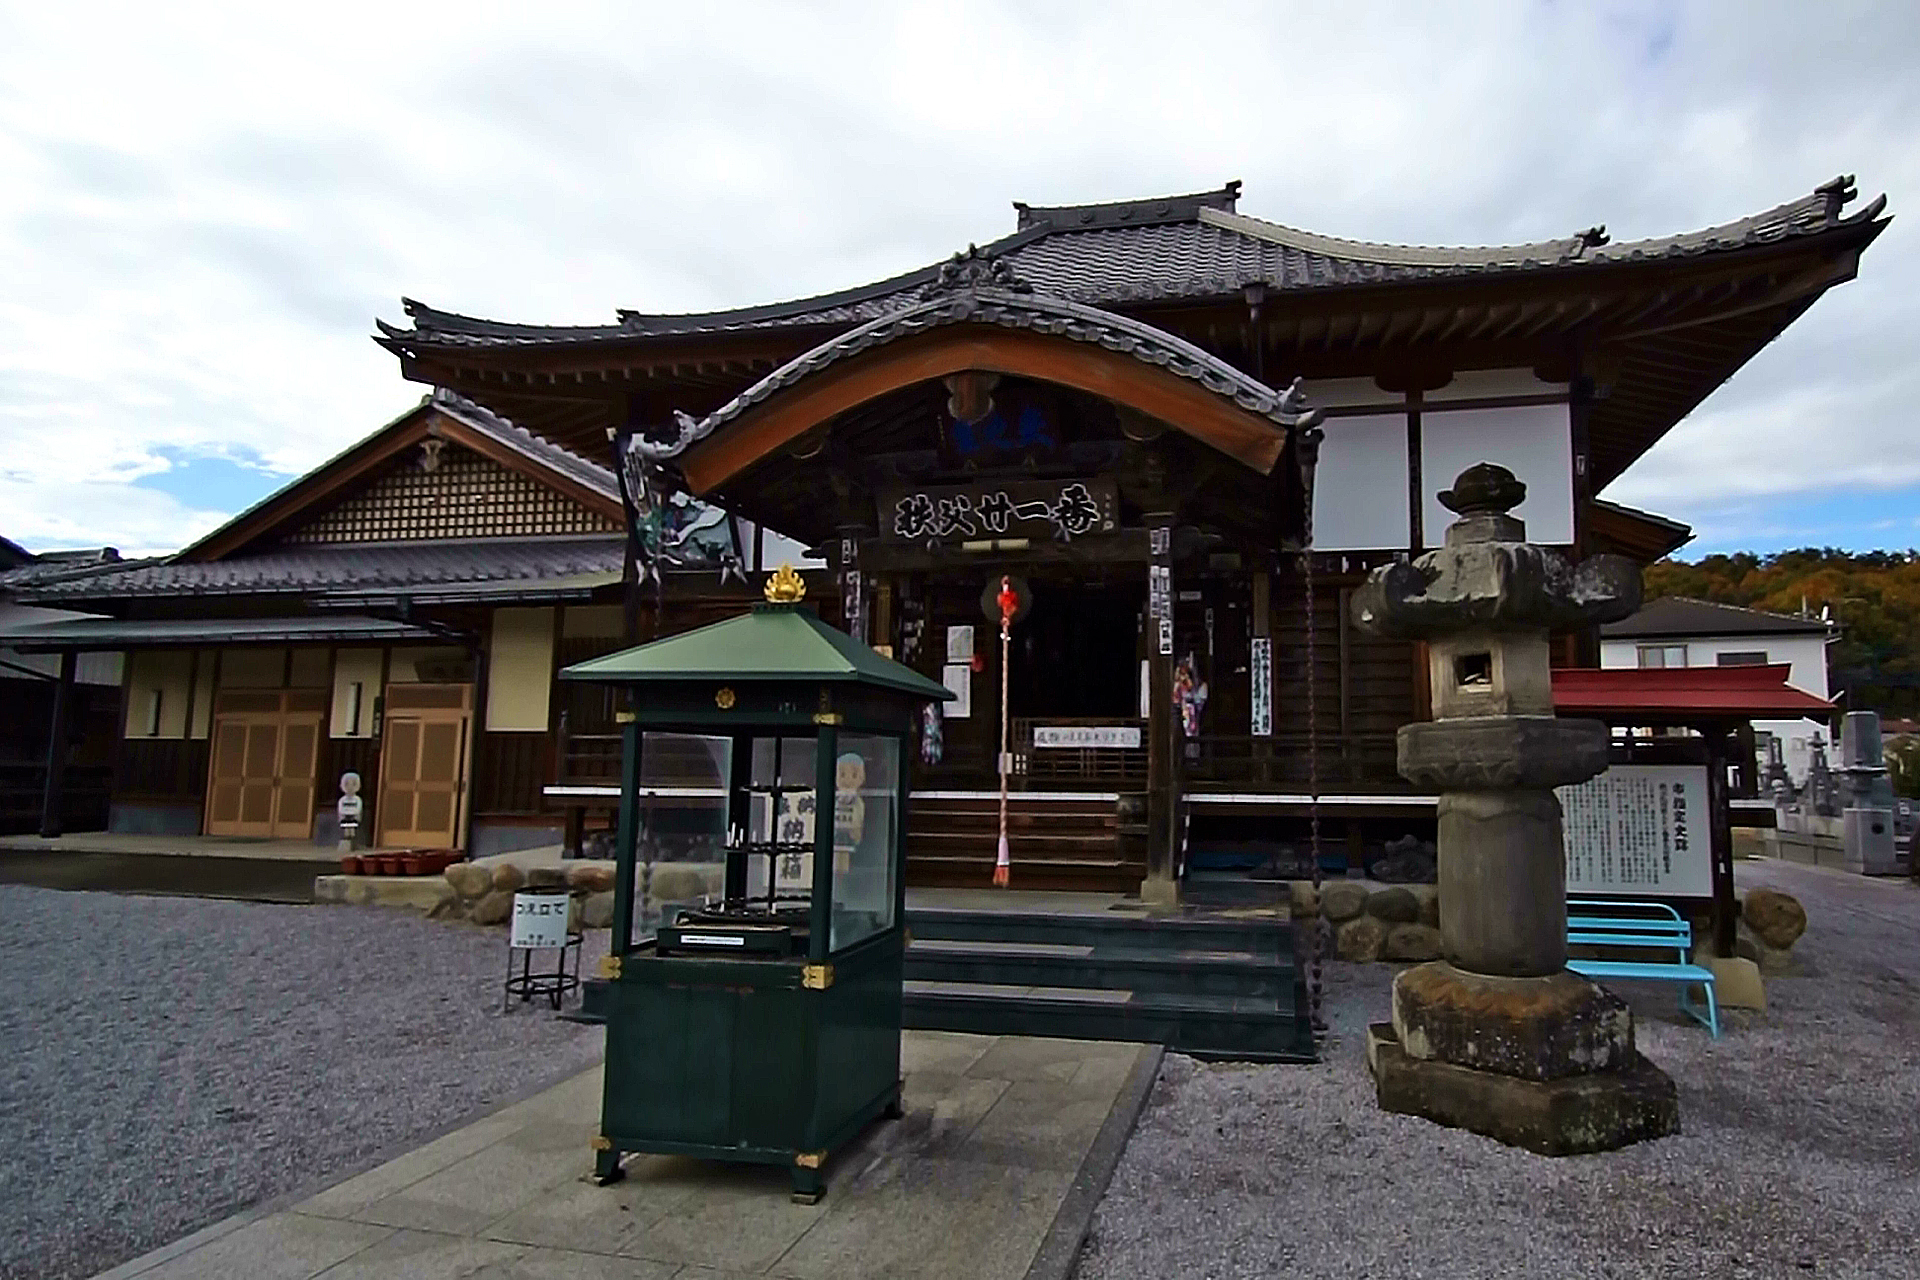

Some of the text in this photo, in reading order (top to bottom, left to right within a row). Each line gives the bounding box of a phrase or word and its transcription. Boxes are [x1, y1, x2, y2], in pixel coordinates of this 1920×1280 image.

[894, 483, 1101, 539] 秩父廿一番
[516, 902, 566, 916] つえ立て
